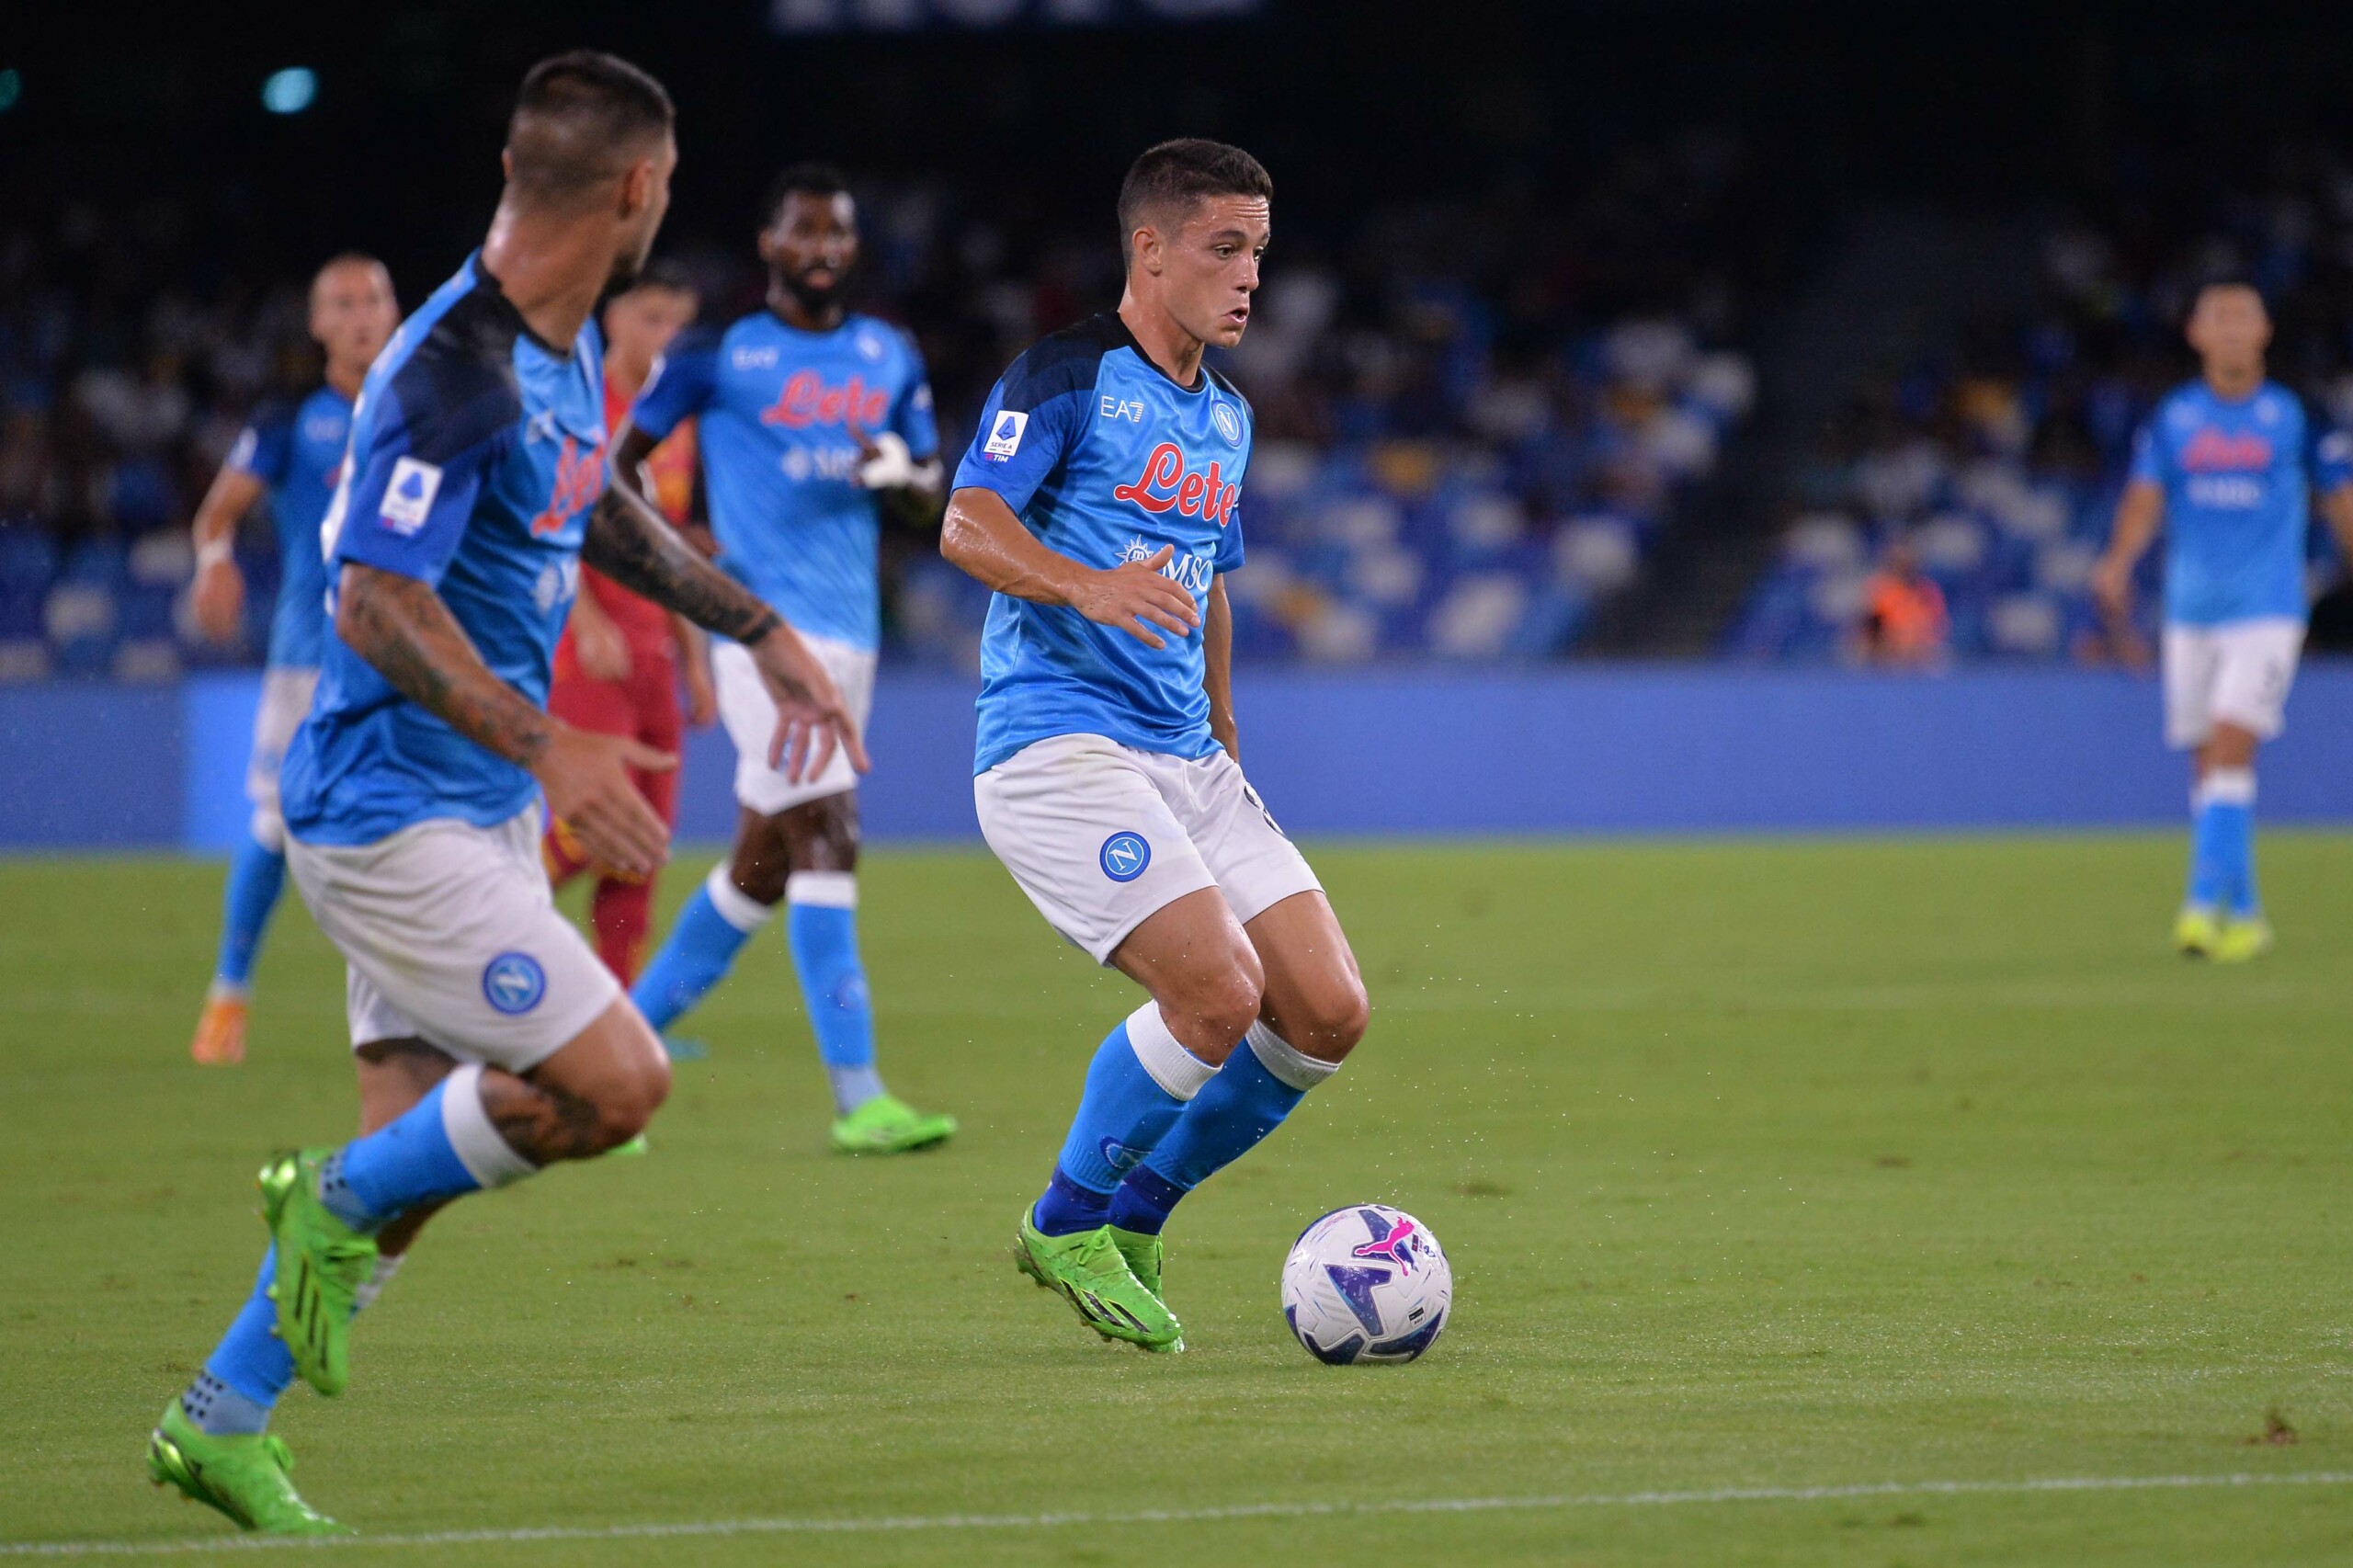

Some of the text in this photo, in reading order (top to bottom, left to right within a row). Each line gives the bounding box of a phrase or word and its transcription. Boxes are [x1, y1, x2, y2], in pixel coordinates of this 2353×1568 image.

[759, 368, 890, 428] Lete
[1101, 395, 1144, 423] EA7
[990, 441, 1008, 449] SERIE
[993, 454, 1009, 463] TIM
[1113, 442, 1237, 528] Lete
[1161, 547, 1213, 592] MSC
[1108, 840, 1138, 871] N
